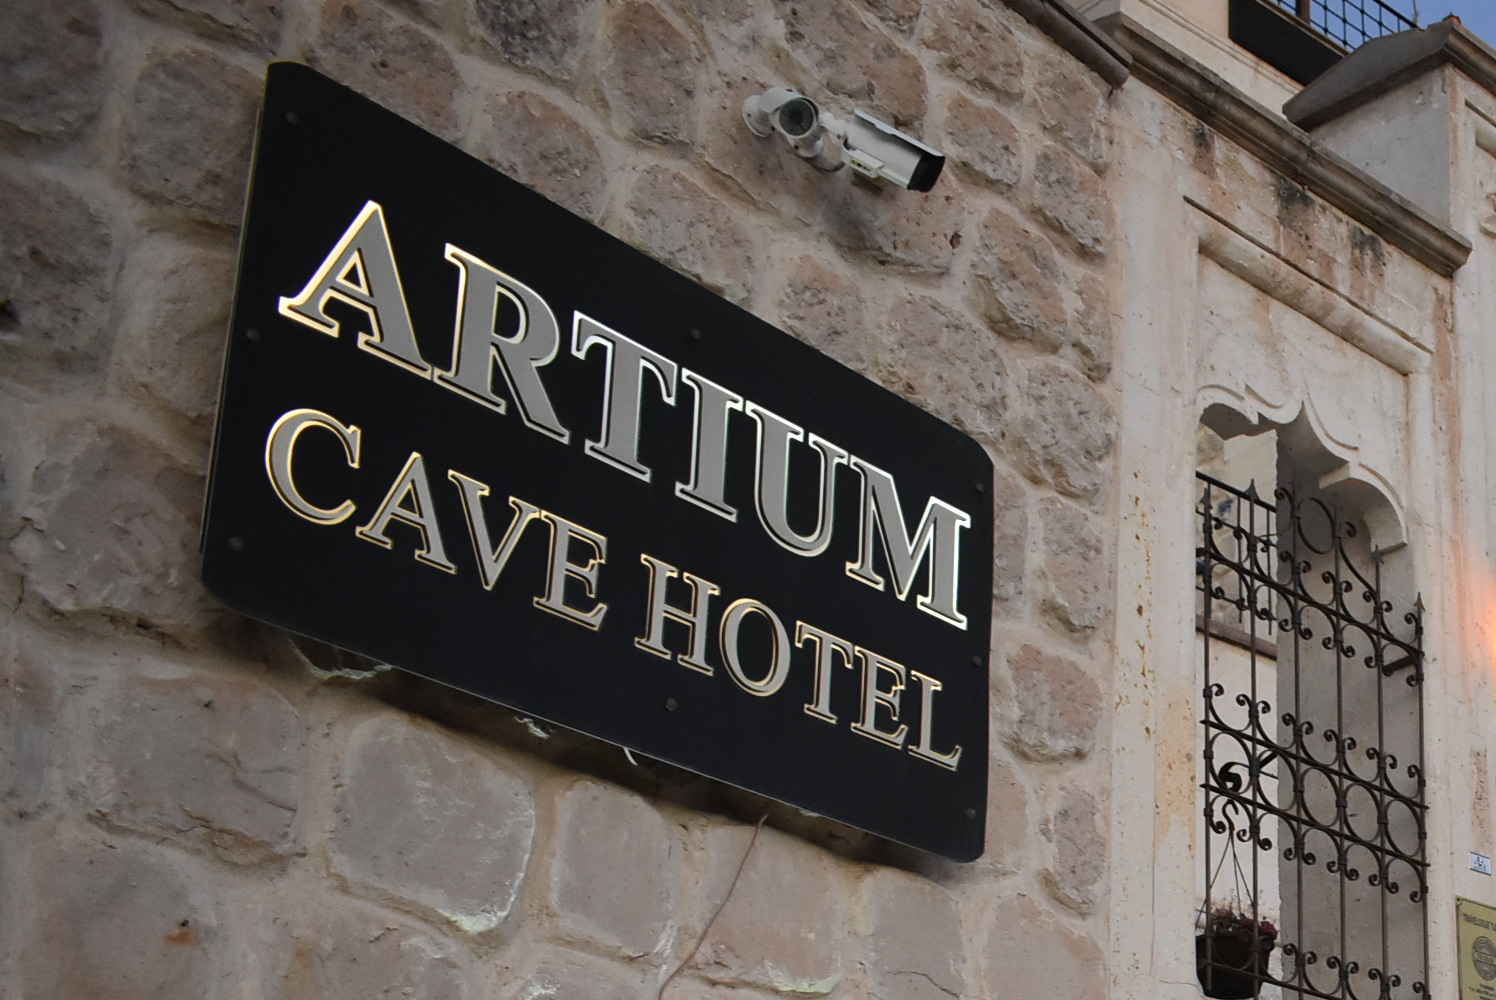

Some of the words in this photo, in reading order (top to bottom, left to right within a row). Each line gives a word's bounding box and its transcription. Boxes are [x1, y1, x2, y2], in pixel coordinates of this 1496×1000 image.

[264, 408, 608, 631] CAVE
[635, 553, 963, 772] HOTEL
[277, 200, 971, 631] ARTIUM
